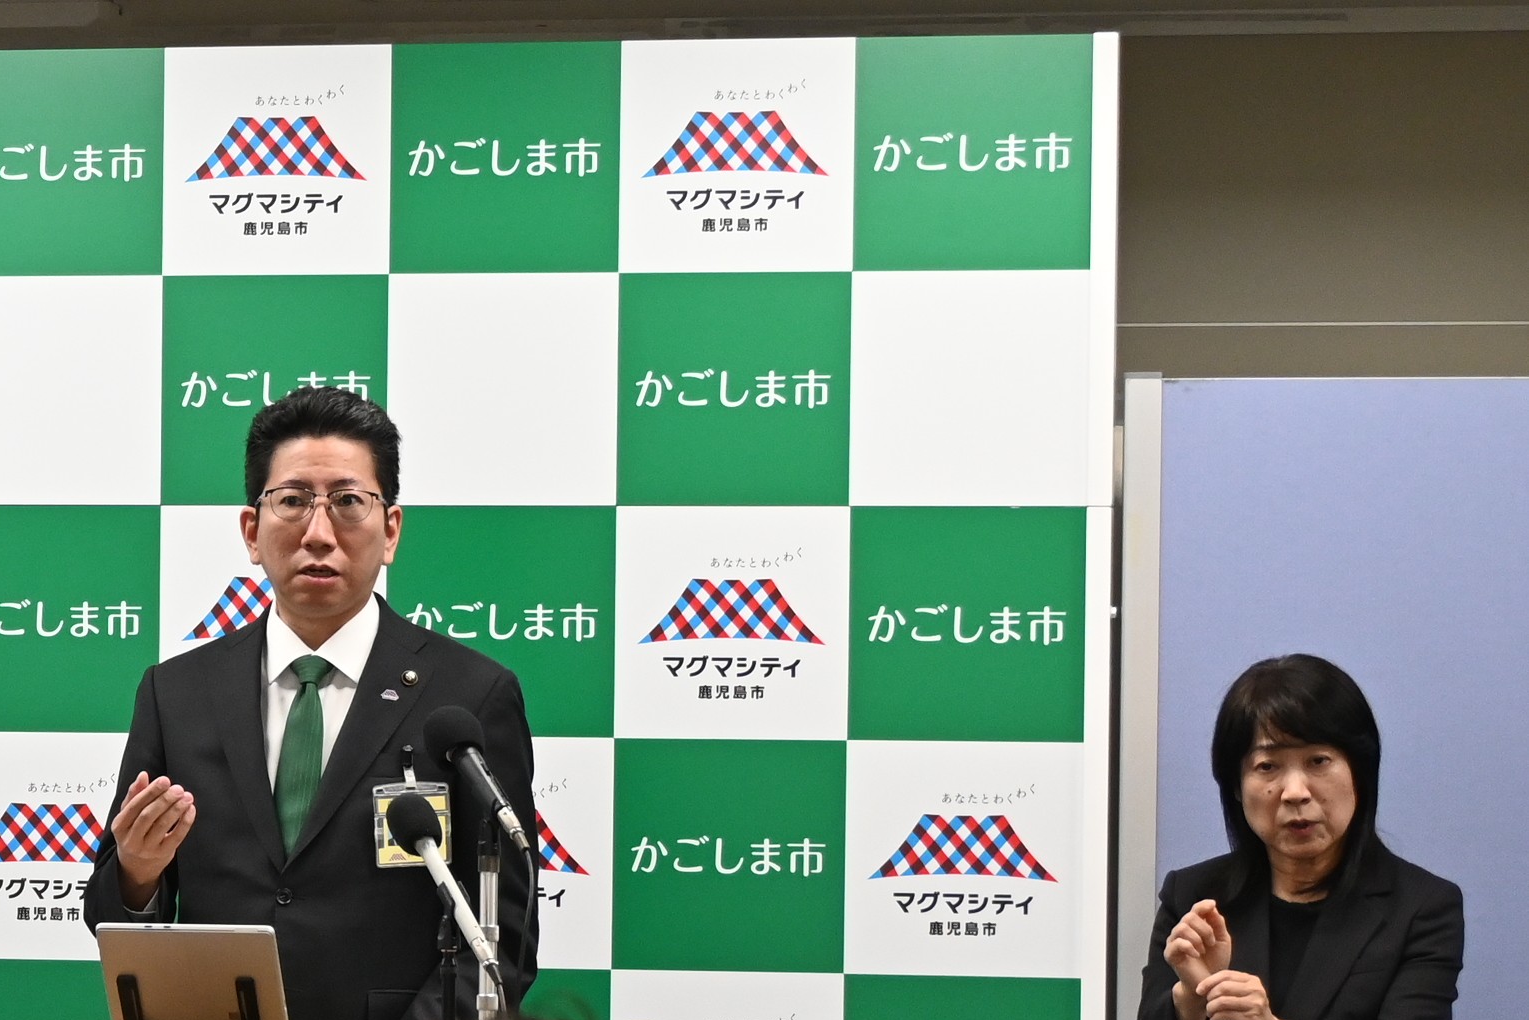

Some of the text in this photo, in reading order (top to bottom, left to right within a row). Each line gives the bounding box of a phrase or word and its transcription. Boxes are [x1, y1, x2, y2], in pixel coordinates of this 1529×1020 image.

[255, 84, 345, 106] あなたとわくわく
[714, 78, 806, 101] あなたとわくわく
[408, 137, 602, 177] かごしま市
[873, 131, 1073, 173] かごしま市
[208, 192, 344, 215] マグマシティ
[666, 188, 805, 211] マグマシティ
[243, 221, 309, 236] 鹿児島市
[701, 217, 768, 233] 鹿児島市
[635, 368, 832, 409] かごしま市
[710, 547, 802, 568] あなたとわくわく
[405, 601, 600, 643] かごしま市
[867, 603, 1067, 646] かごしま市
[662, 655, 801, 678] マグマシティ
[698, 684, 765, 700] 鹿児島市
[27, 773, 116, 793] あなたとわくわく
[941, 783, 1035, 805] あなたとわくわく
[630, 835, 827, 878] かごしま市
[16, 906, 80, 922] 鹿児島市
[893, 891, 1034, 916] マグマシティ
[929, 921, 997, 937] 鹿児島市
